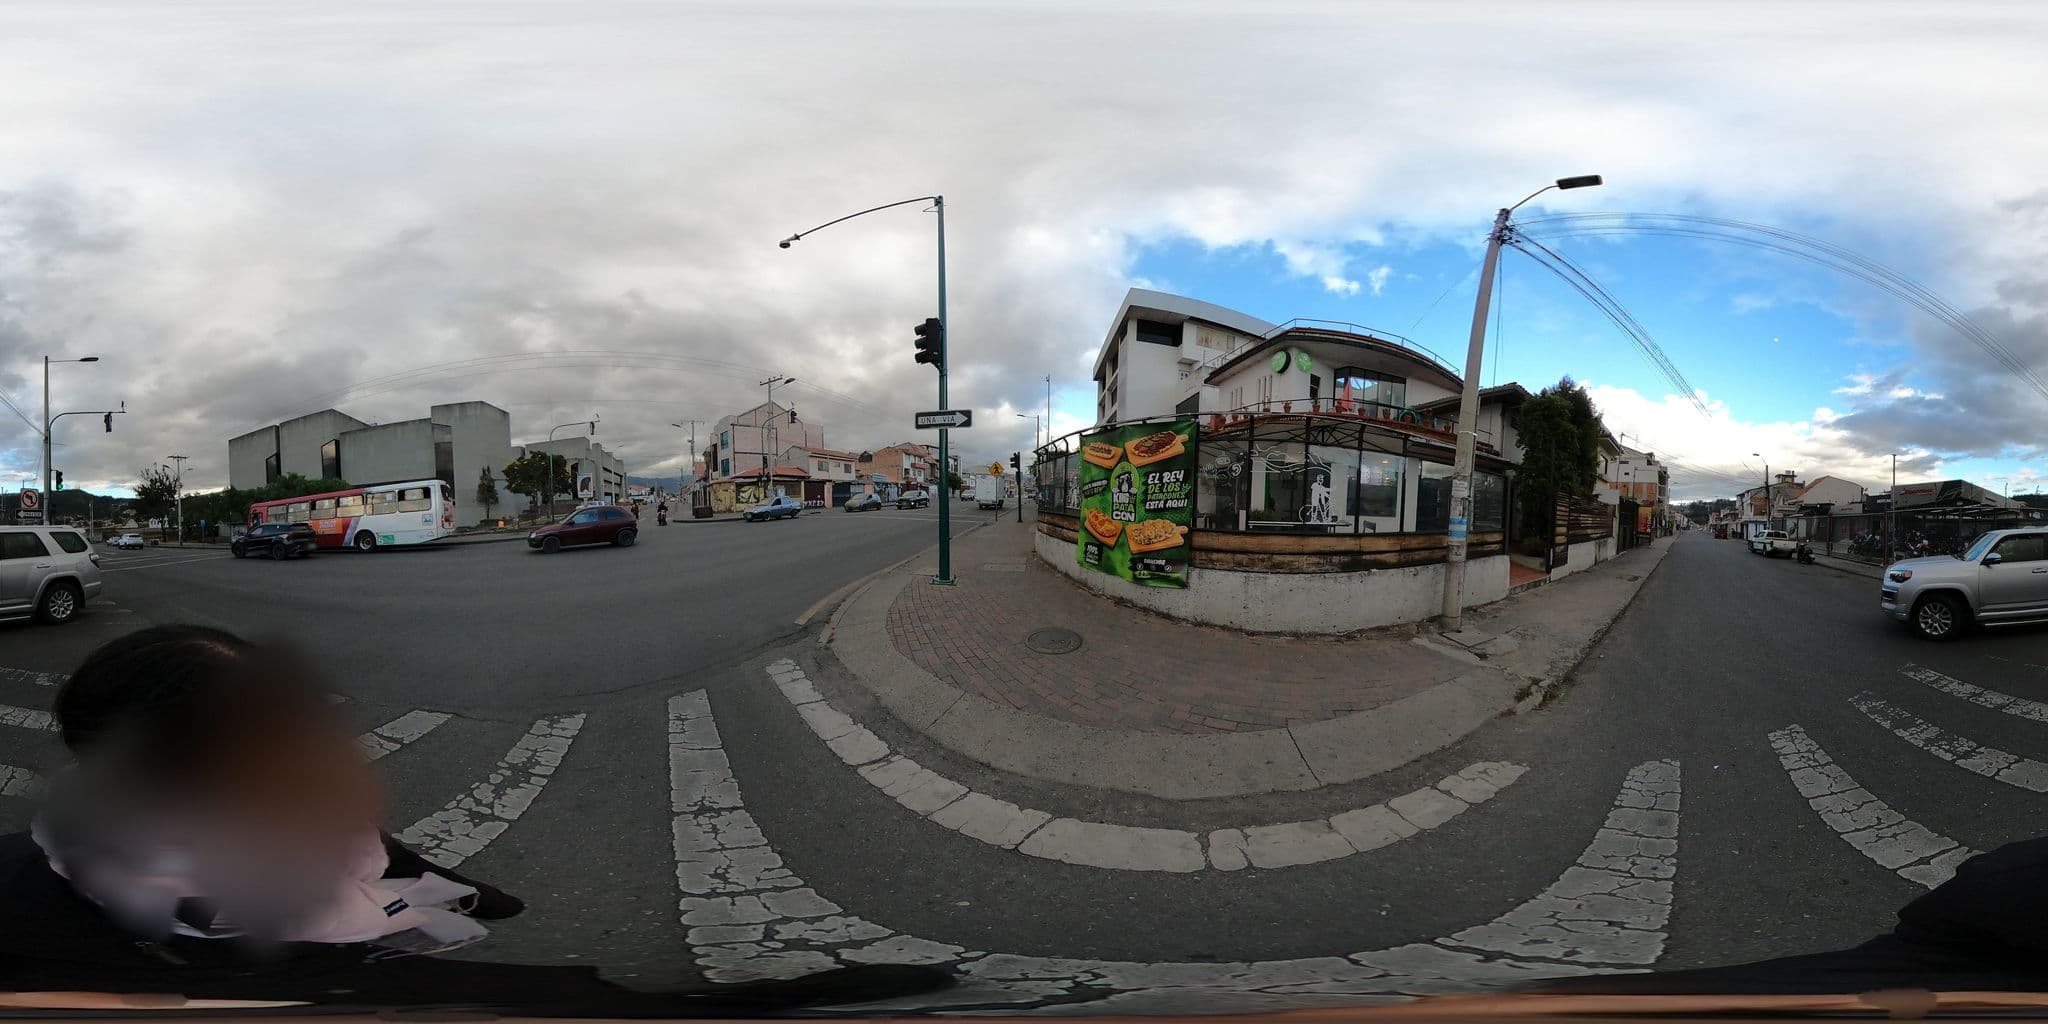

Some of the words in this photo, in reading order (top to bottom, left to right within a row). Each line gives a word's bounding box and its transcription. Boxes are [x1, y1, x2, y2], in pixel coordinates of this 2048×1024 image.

[920, 416, 937, 424] UNA
[1148, 472, 1160, 484] EL
[1162, 470, 1184, 483] REY
[1148, 484, 1161, 493] DE
[1163, 482, 1181, 492] LOS
[1147, 492, 1185, 500] PATACONES
[1113, 503, 1135, 512] PATA
